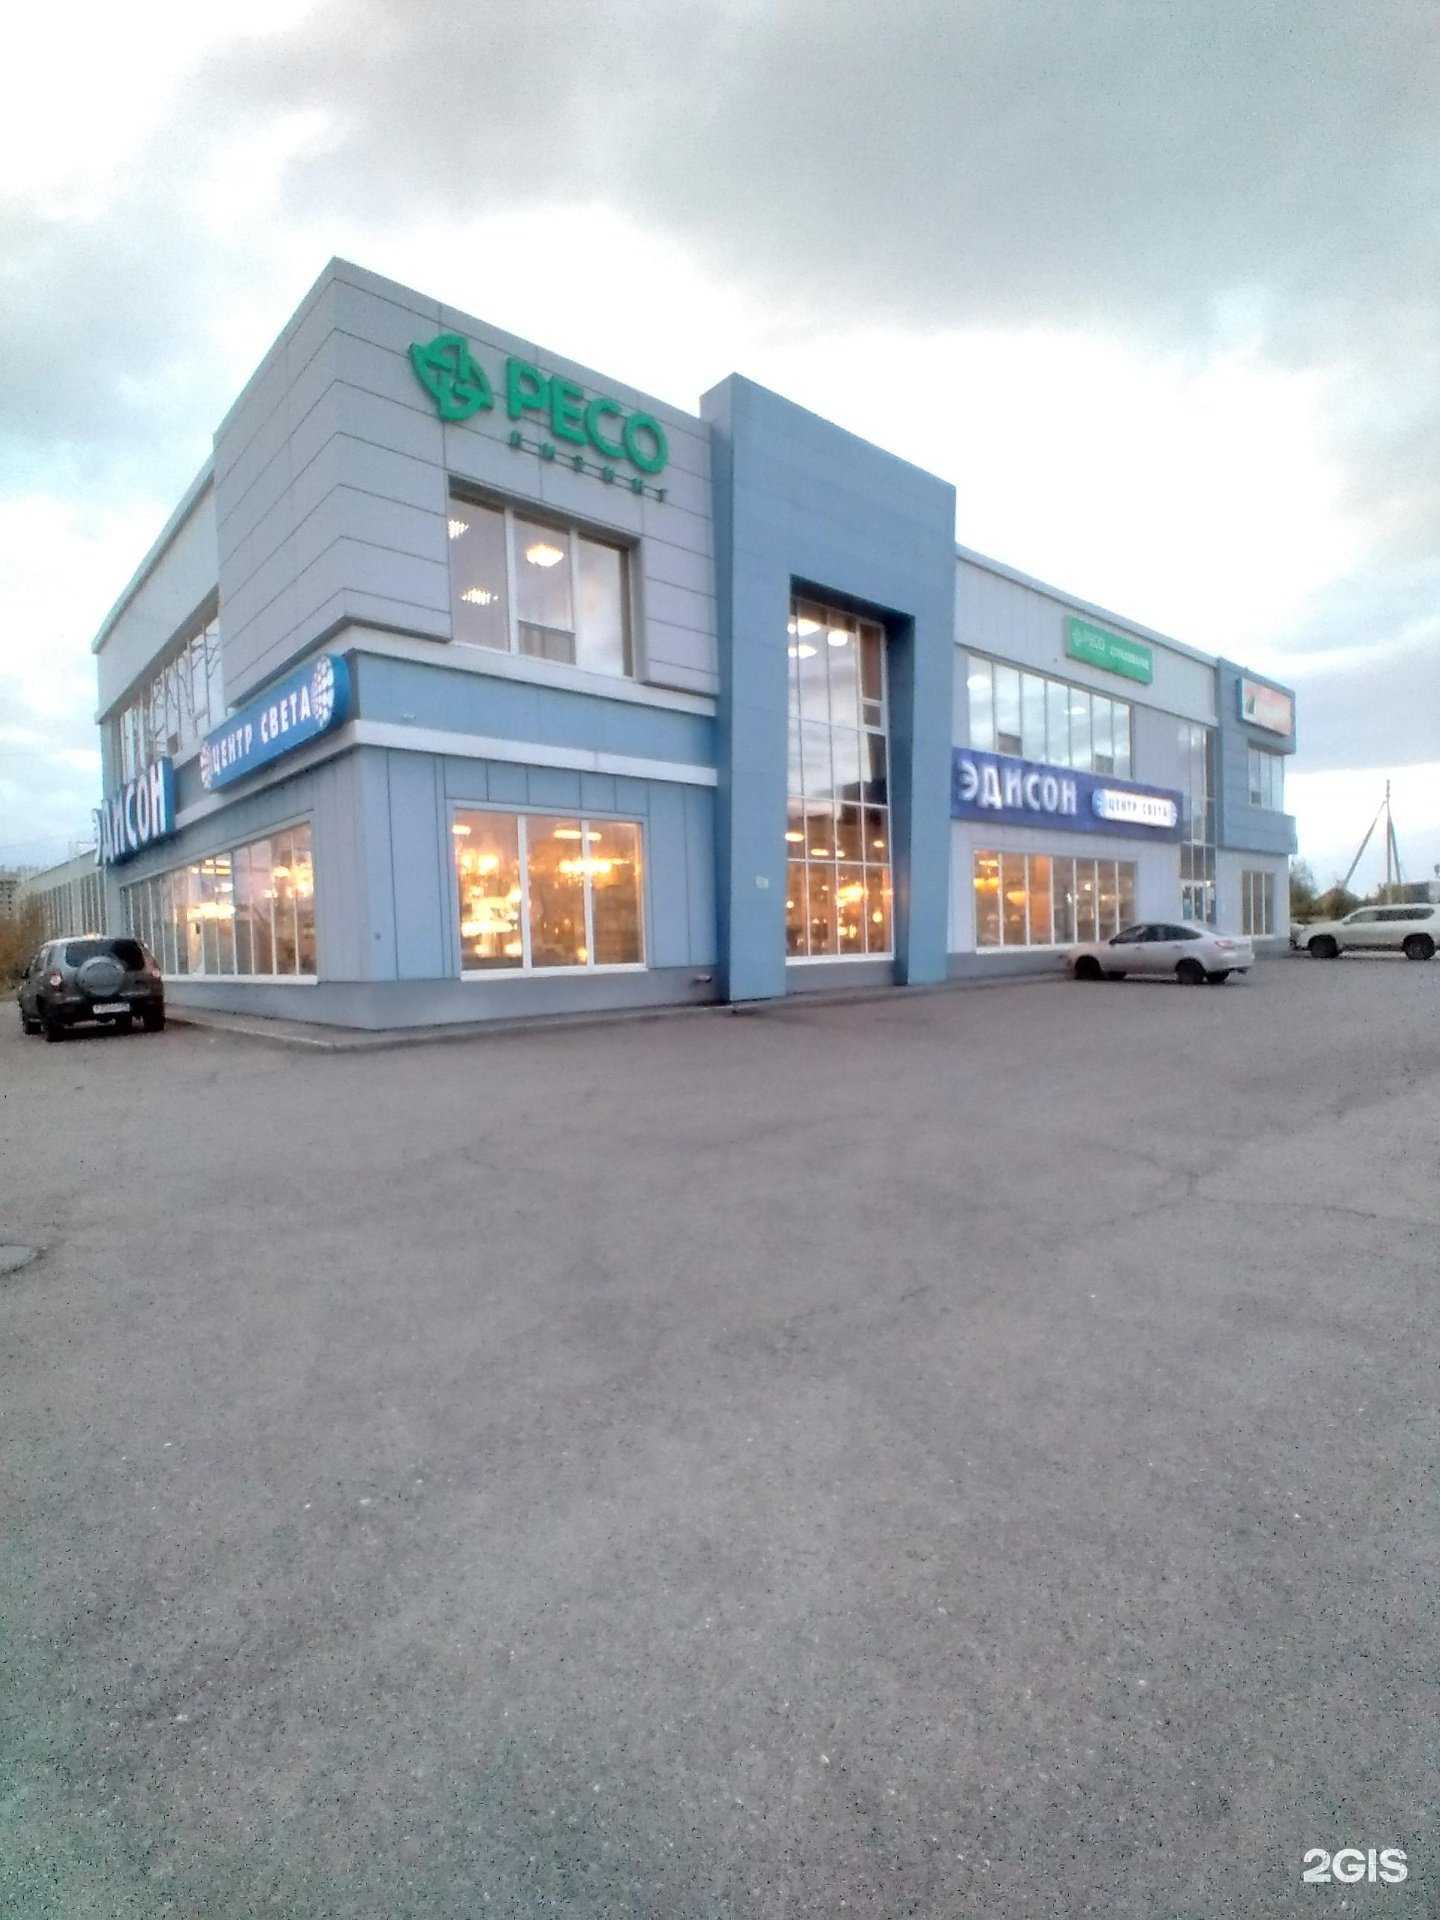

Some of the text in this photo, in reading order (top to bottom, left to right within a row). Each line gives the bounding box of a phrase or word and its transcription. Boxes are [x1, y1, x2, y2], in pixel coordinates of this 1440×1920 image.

[506, 355, 669, 475] РЕСО
[212, 686, 311, 776] ЦЕНТР СВЕТА
[958, 759, 1077, 815] ЭДИСОН
